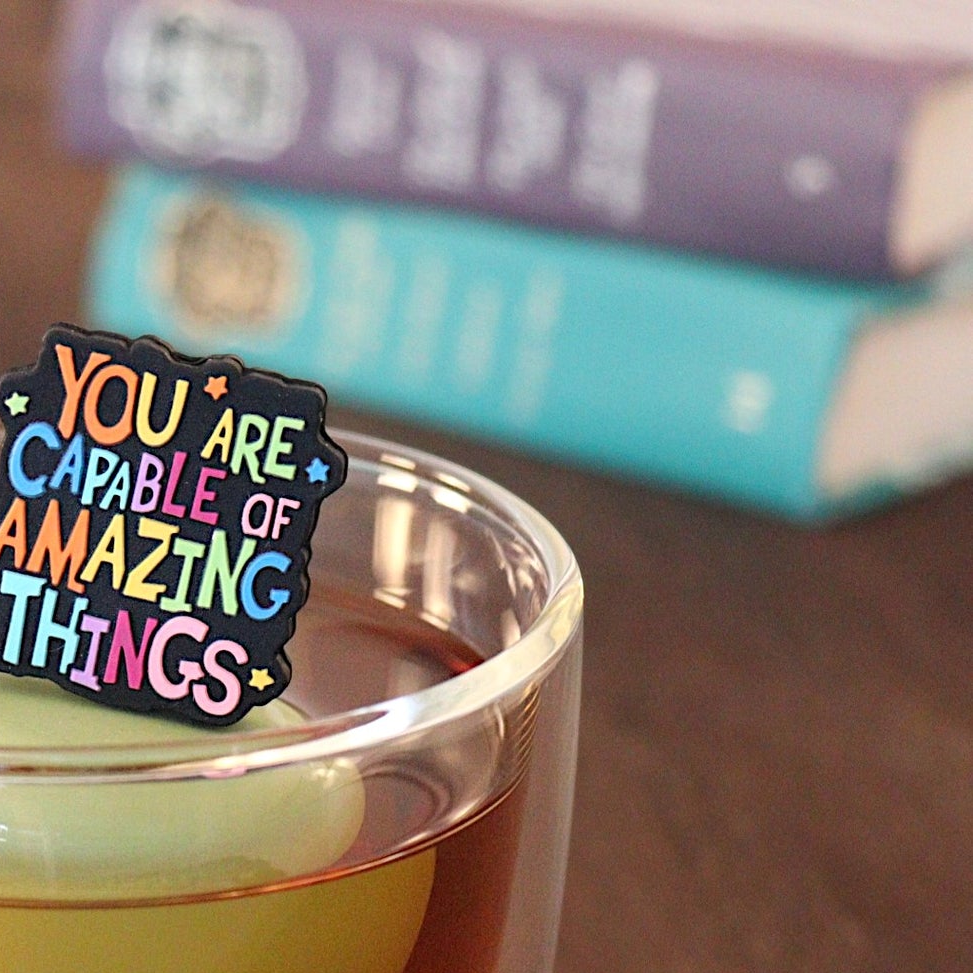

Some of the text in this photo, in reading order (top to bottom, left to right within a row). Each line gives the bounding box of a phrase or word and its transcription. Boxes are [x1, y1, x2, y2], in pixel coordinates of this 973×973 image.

[8, 421, 300, 540] CAPABLE OF
[55, 344, 305, 484] YOU ARE
[0, 570, 248, 716] THINGS
